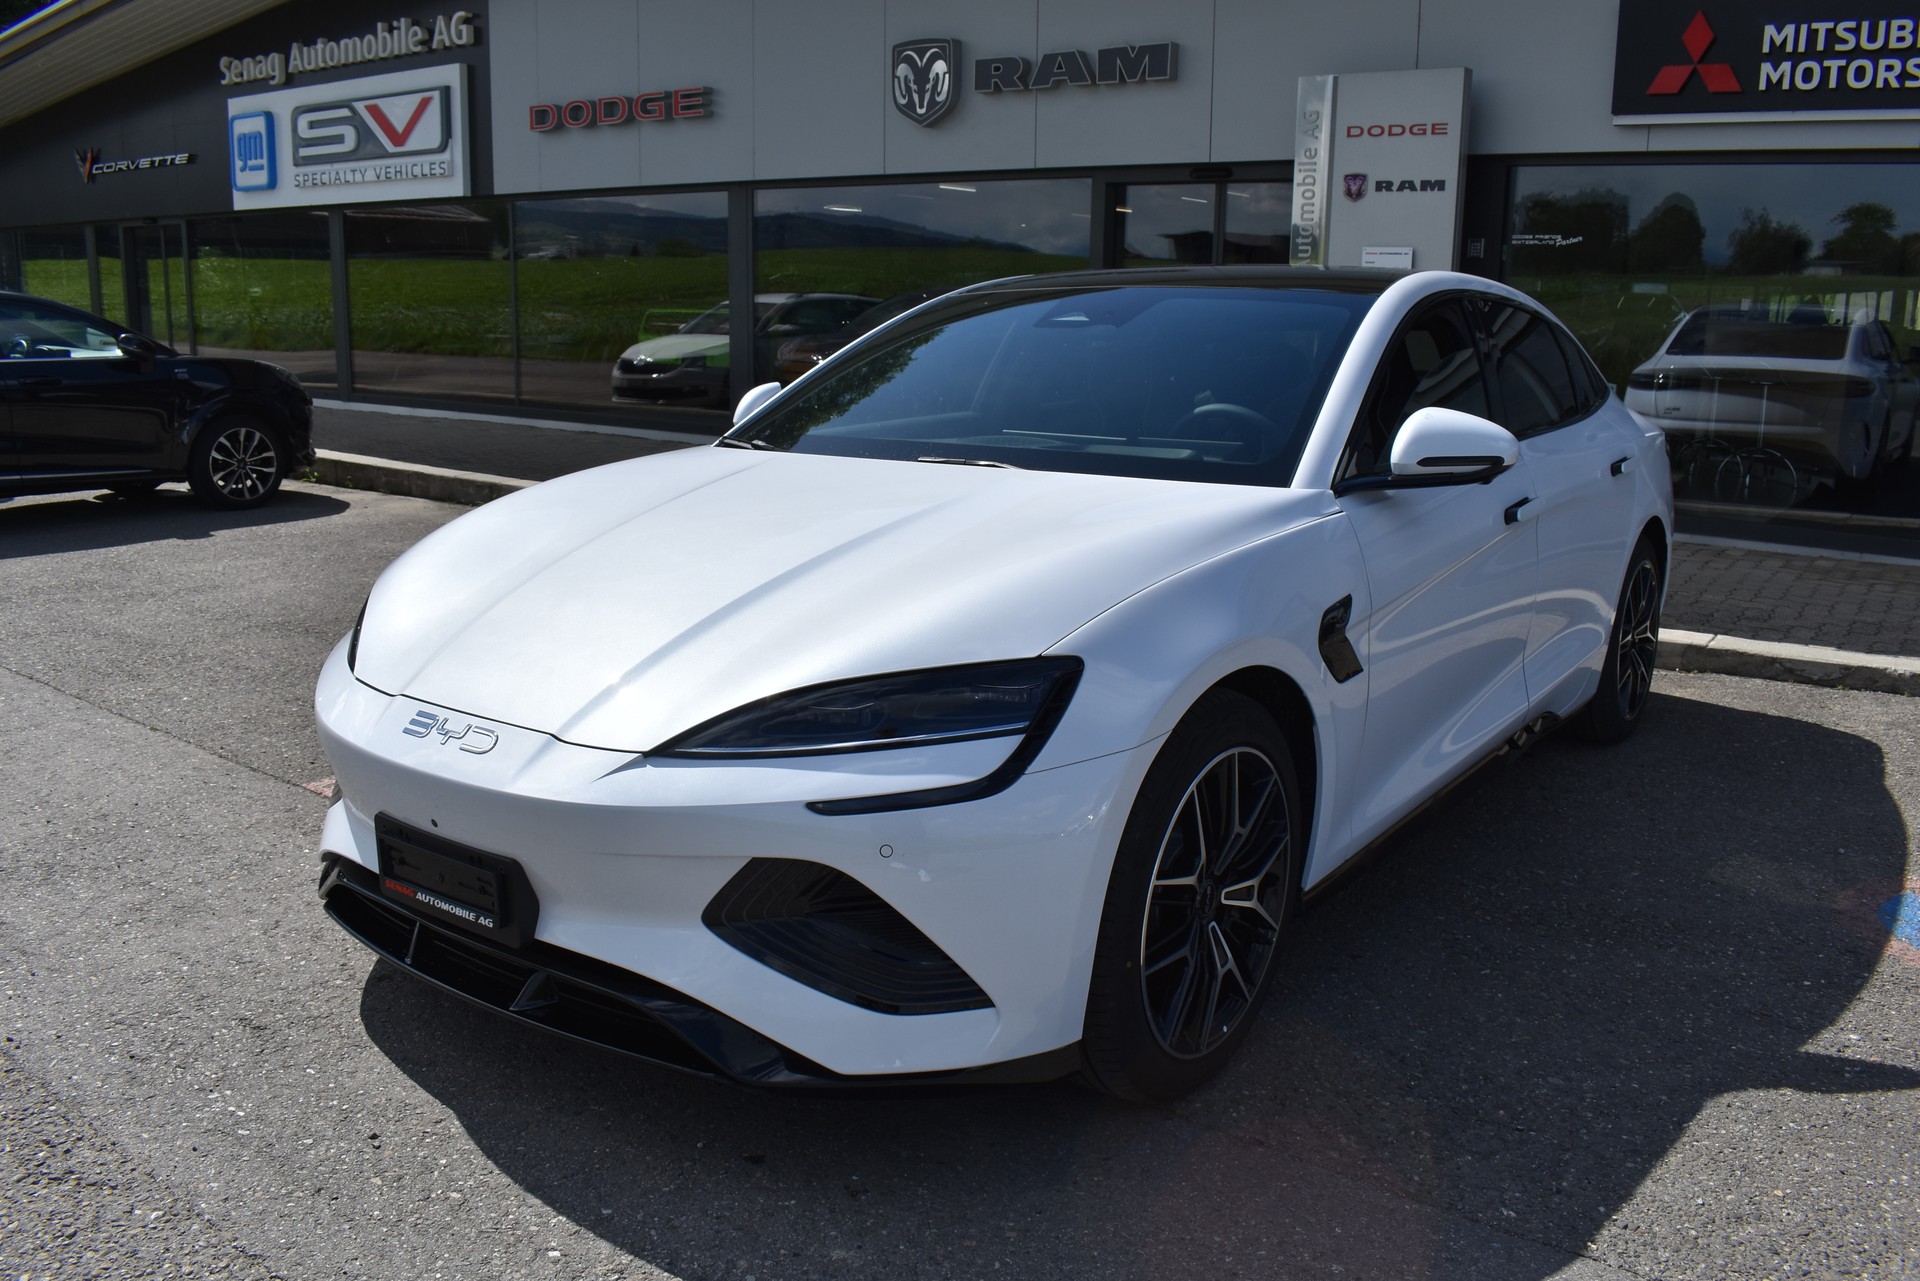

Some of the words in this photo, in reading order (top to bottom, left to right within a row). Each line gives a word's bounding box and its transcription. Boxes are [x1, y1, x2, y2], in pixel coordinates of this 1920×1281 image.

[219, 52, 286, 85] Senag
[288, 17, 429, 74] Automobile
[432, 11, 475, 50] AG
[974, 41, 1179, 93] RAM
[297, 95, 434, 157] SV
[529, 86, 714, 132] DODGE
[1304, 109, 1320, 140] AG
[1346, 122, 1449, 138] DODGE
[92, 153, 190, 174] CORVETTE
[294, 167, 368, 188] SPECIALTY
[374, 161, 447, 181] VEHICLES
[1375, 179, 1446, 193] RAM
[402, 709, 499, 755] BYD
[385, 879, 415, 897] SENAG
[415, 891, 476, 923] AUTOMOBILE
[477, 915, 494, 929] AG
